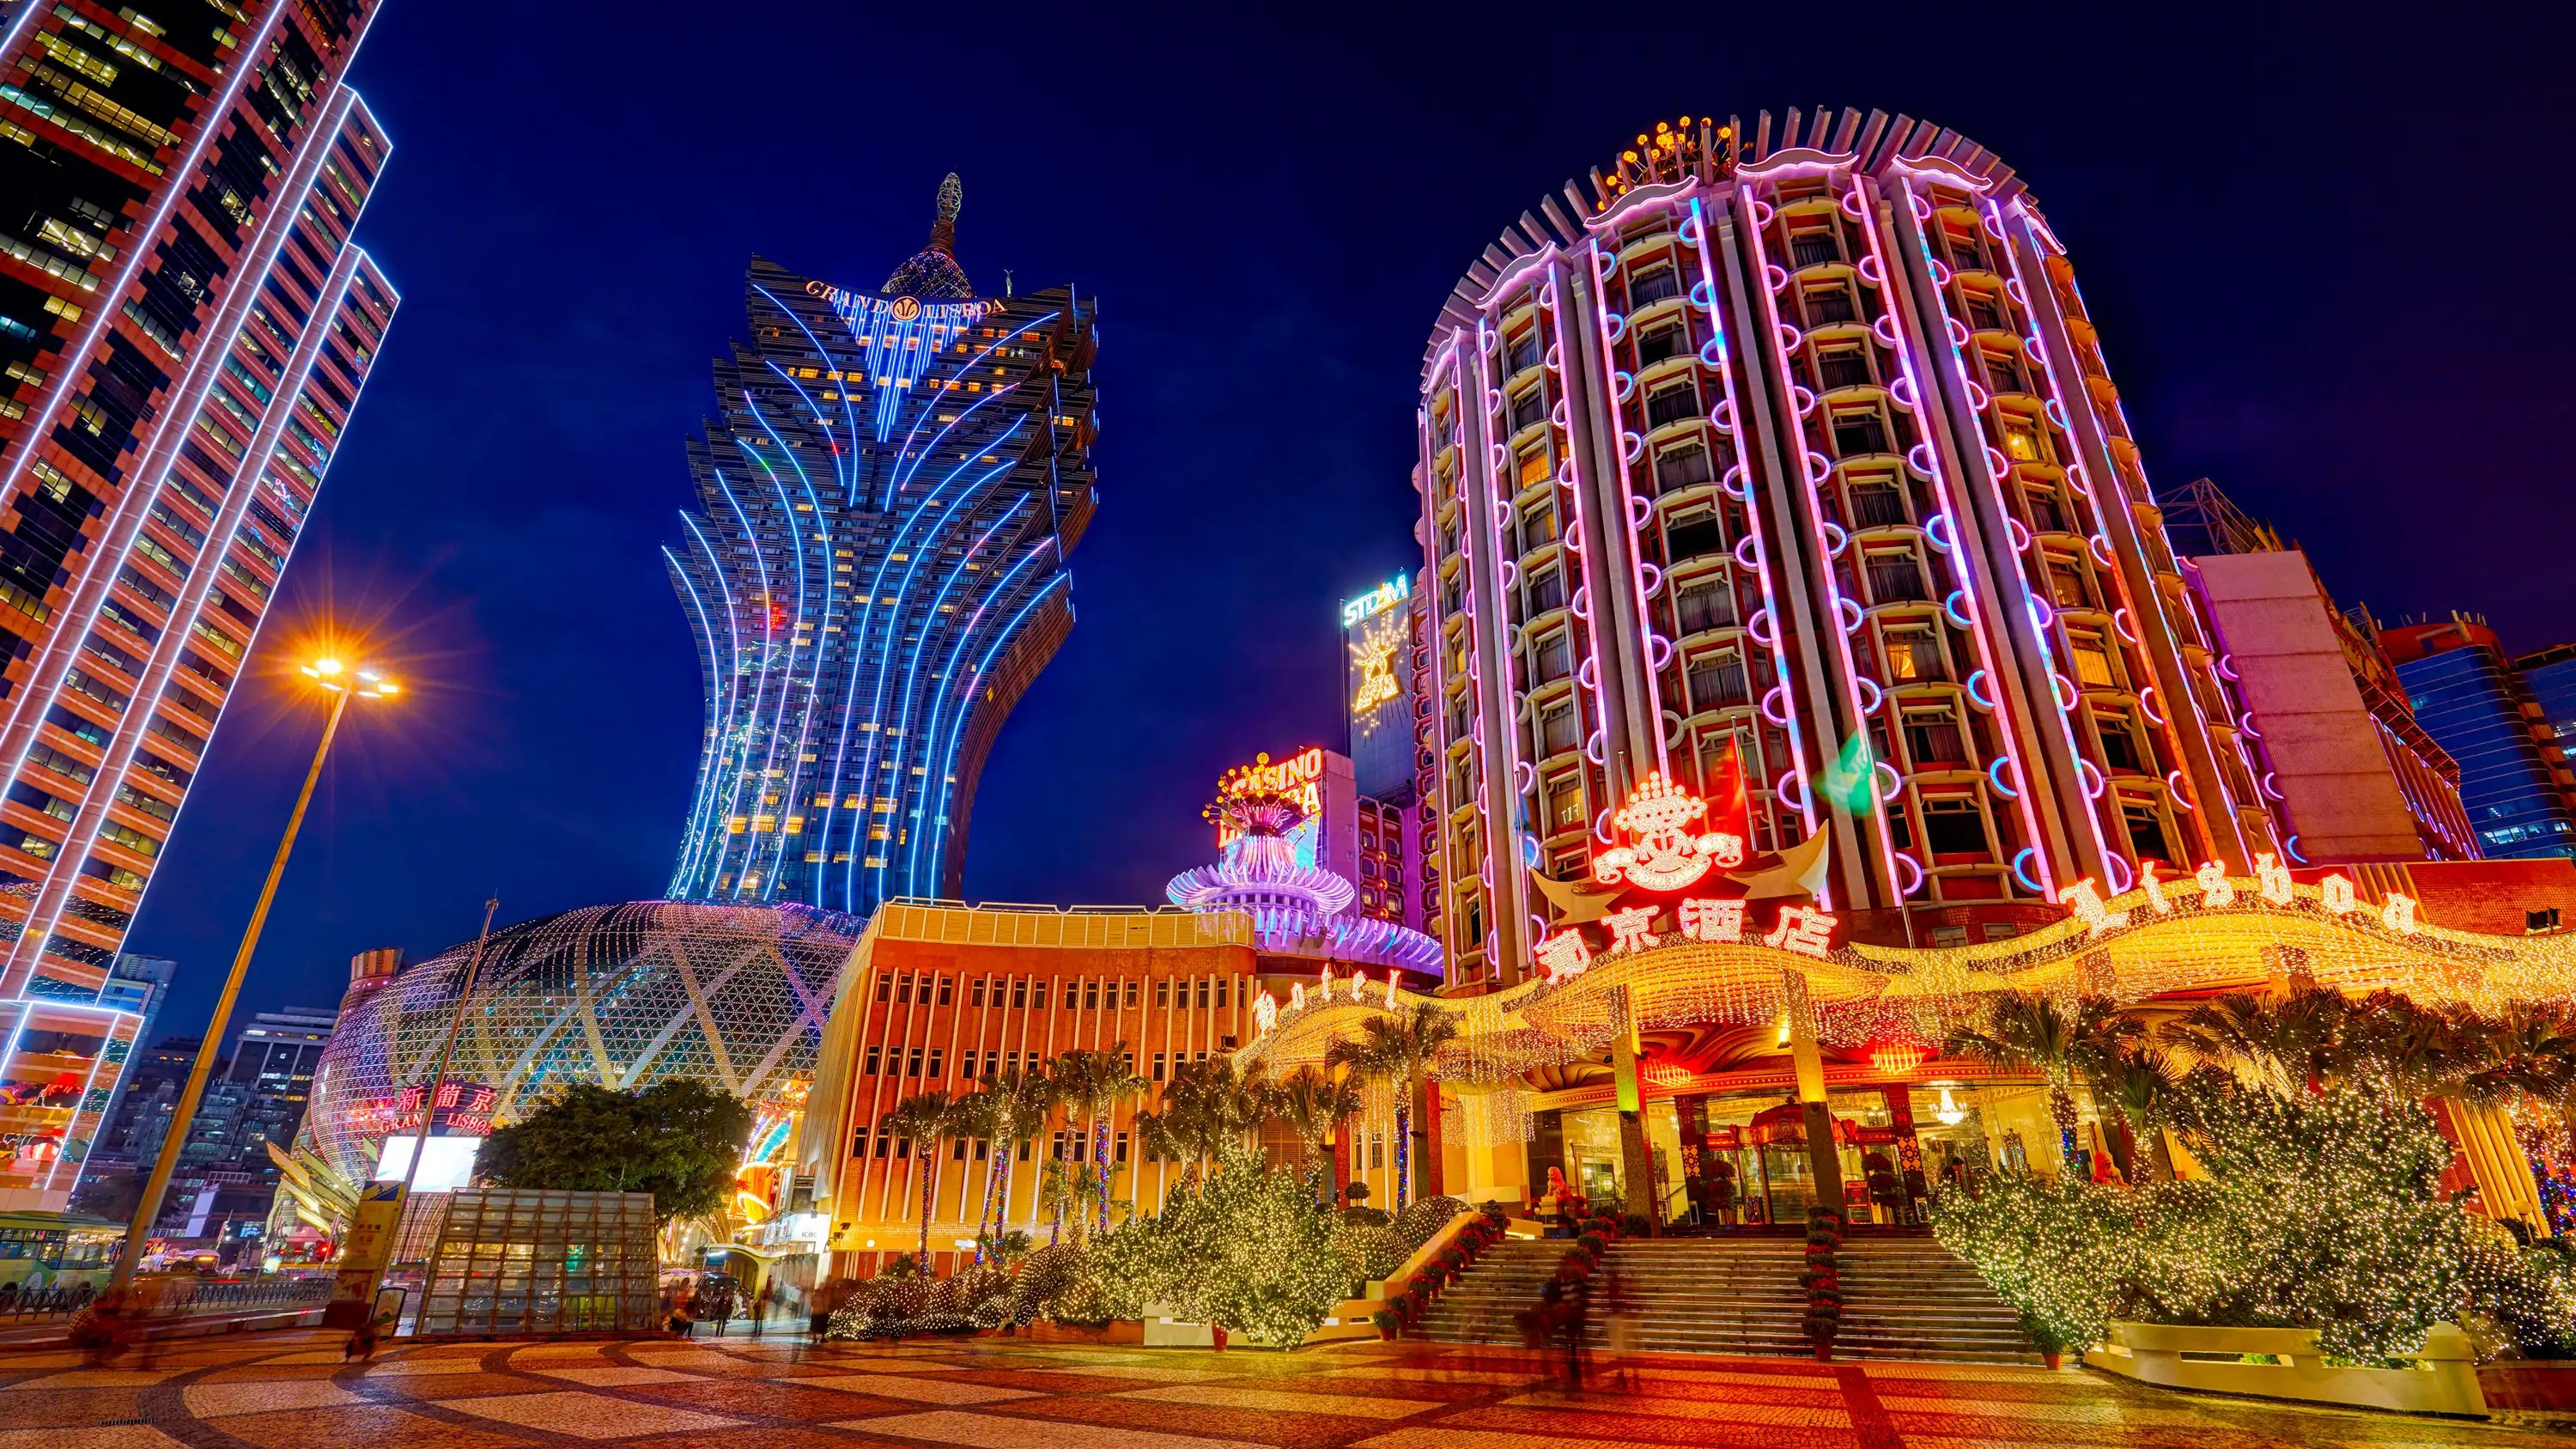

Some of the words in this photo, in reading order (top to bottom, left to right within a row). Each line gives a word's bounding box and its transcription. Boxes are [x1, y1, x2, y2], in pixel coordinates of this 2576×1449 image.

[805, 280, 890, 314] GRAND
[926, 298, 1008, 319] LISBOA
[2058, 853, 2417, 940] Lisboa
[1536, 898, 1838, 986] 葡京酒店
[396, 1083, 498, 1113] 新葡京
[380, 1112, 431, 1134] GRAN
[446, 1112, 495, 1135] LISBOA
